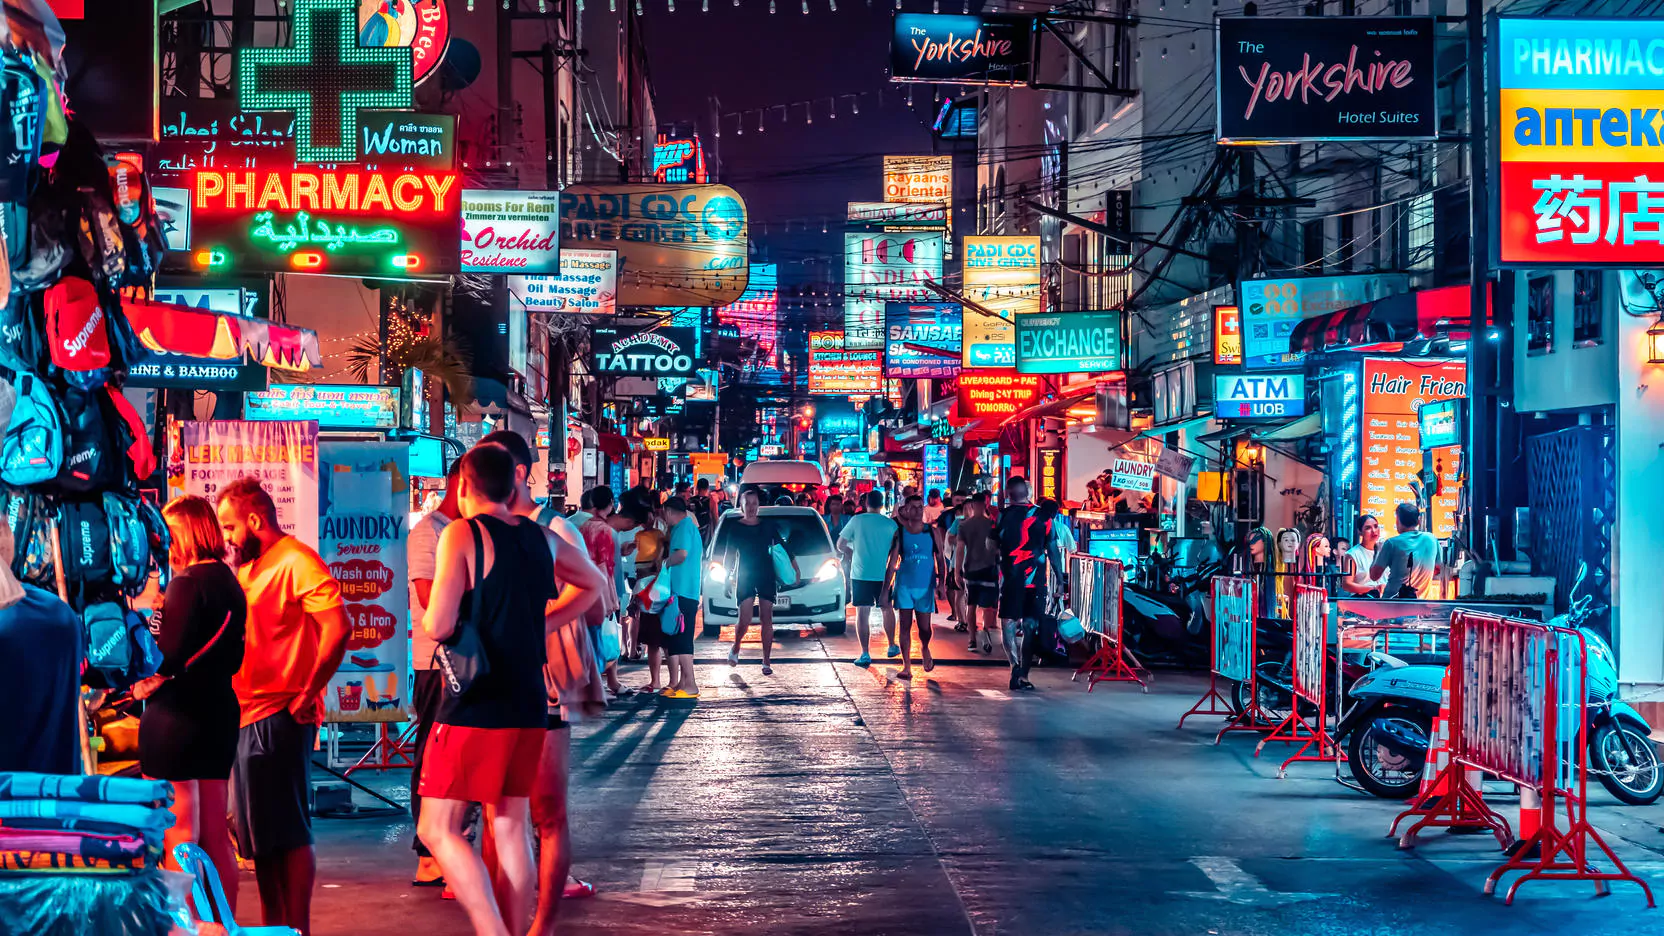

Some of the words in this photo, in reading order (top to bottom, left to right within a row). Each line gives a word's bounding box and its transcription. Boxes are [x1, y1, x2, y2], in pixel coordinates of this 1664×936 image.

[910, 26, 926, 36] The
[911, 28, 1012, 71] Yorkshire
[1237, 41, 1264, 53] The
[1238, 44, 1413, 120] Yorkshire
[1338, 111, 1376, 123] Hotel
[1379, 111, 1419, 123] Suites
[1514, 107, 1664, 147] аптек
[362, 121, 442, 156] Woman
[196, 171, 455, 212] PHARMACY
[887, 184, 947, 197] Oriental
[462, 201, 502, 212] Rooms
[505, 202, 525, 212] For
[527, 202, 555, 213] Rent
[561, 193, 630, 220] PADI
[640, 194, 697, 220] CDC
[905, 207, 946, 221] FOOD
[1532, 174, 1664, 245] 药店
[465, 212, 496, 221] Zimmer
[508, 213, 549, 222] vermieten
[474, 226, 556, 251] Orchid
[967, 244, 1002, 257] PADI
[1007, 244, 1036, 257] CDC
[462, 249, 528, 268] Residence
[571, 260, 612, 271] Massage
[553, 275, 601, 285] Massage
[860, 269, 937, 284] INDIAN
[527, 284, 543, 293] Oil
[549, 285, 597, 297] Massage
[525, 296, 563, 307] Beauty
[568, 298, 599, 308] Salon
[63, 306, 103, 358] Supreme
[612, 332, 681, 355] ACADEMY
[1021, 328, 1115, 358] EXCHANGE
[595, 353, 692, 371] TATTOO
[1079, 360, 1116, 369] SERVICE
[164, 365, 174, 377] &
[179, 366, 238, 379] BAMBOO
[960, 376, 1013, 385] LIVEABOARD
[1370, 372, 1412, 395] Hair
[1419, 374, 1466, 396] Frien
[970, 389, 994, 401] Diving
[1014, 389, 1032, 400] TRIP
[1231, 378, 1289, 399] ATM
[304, 400, 325, 408] Tour
[340, 400, 372, 409] Travel
[975, 403, 1024, 413] TOMORRO
[1253, 402, 1285, 416] UOB
[189, 445, 224, 464] LEK
[191, 470, 225, 481] FOOT
[1114, 460, 1154, 478] LAUNDRY
[204, 483, 217, 493] 50
[318, 515, 404, 540] AUNDRY
[80, 520, 95, 566] Supreme
[336, 542, 382, 557] Service
[329, 566, 363, 580] Wash
[365, 566, 389, 582] only
[358, 613, 367, 626] &
[370, 613, 391, 627] Iron
[92, 625, 127, 661] Supreme
